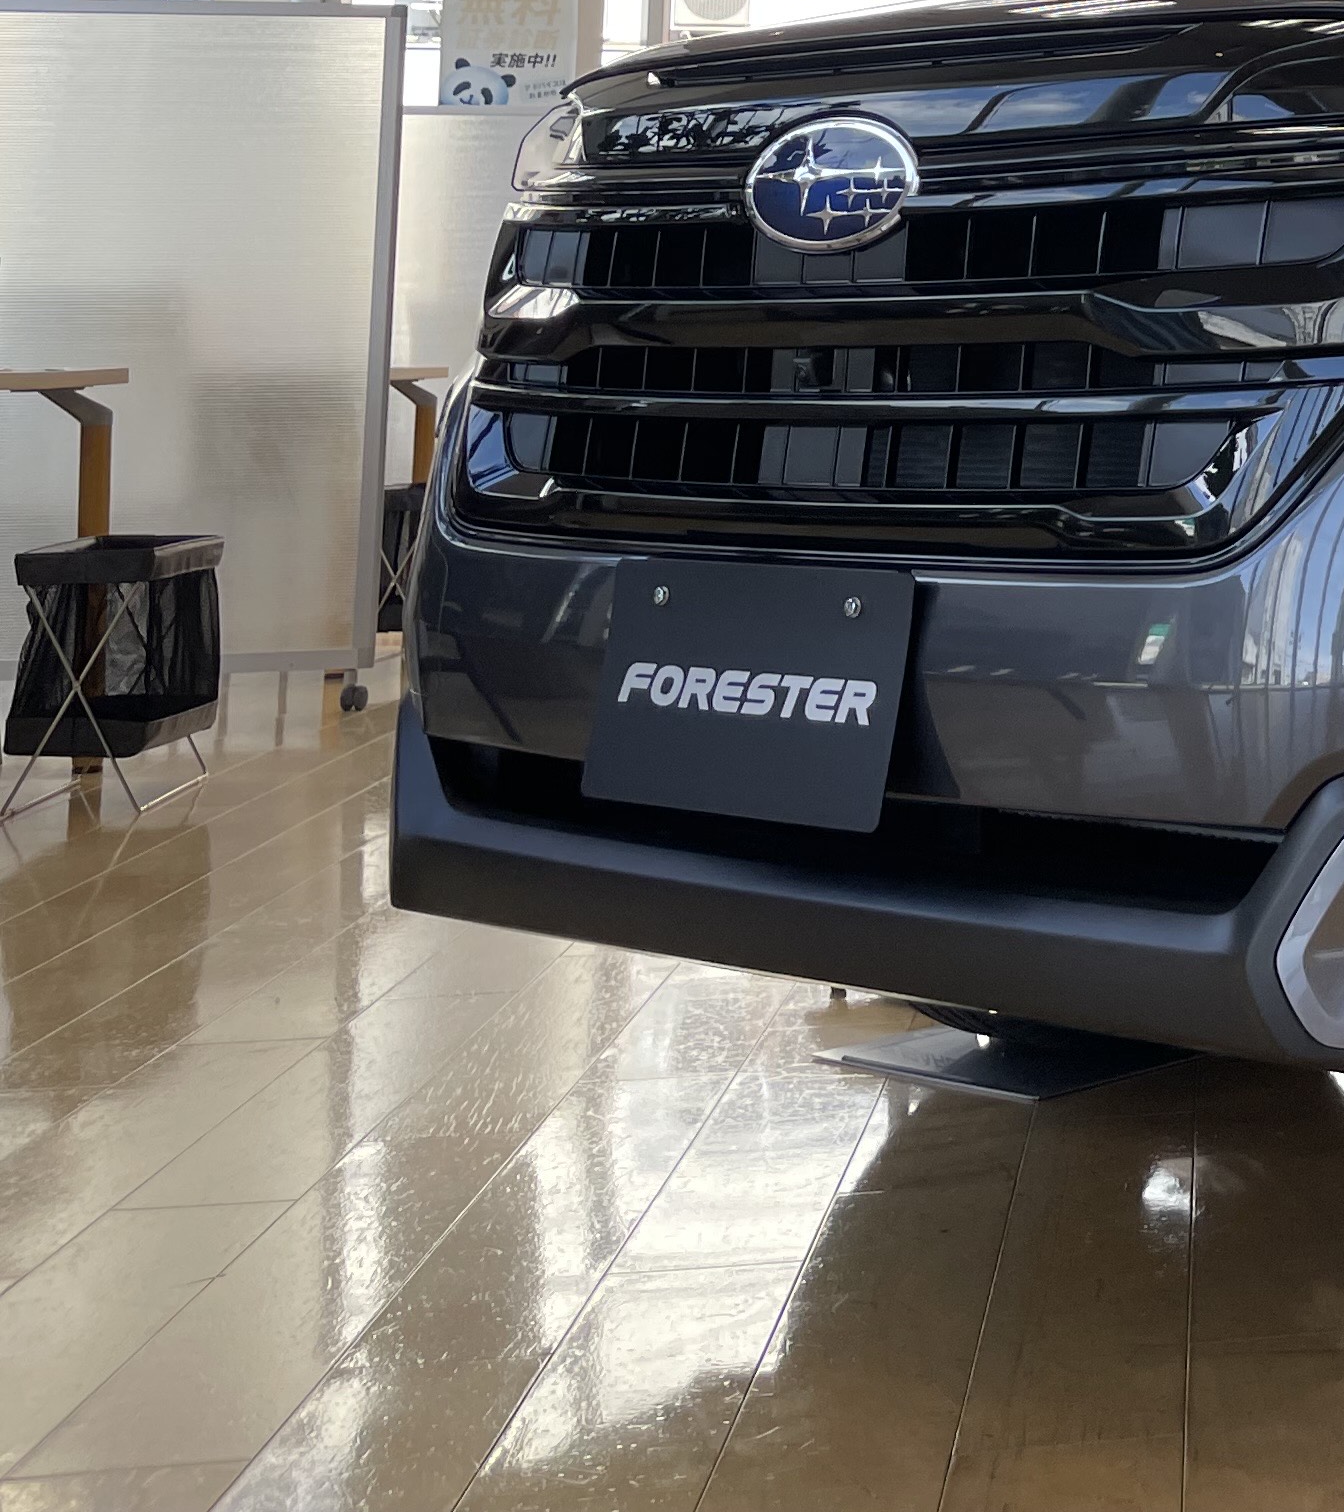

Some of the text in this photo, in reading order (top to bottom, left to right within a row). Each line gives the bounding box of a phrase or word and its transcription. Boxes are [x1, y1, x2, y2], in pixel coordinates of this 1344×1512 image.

[490, 53, 557, 69] 実施中!!
[617, 661, 878, 726] FORESTER
